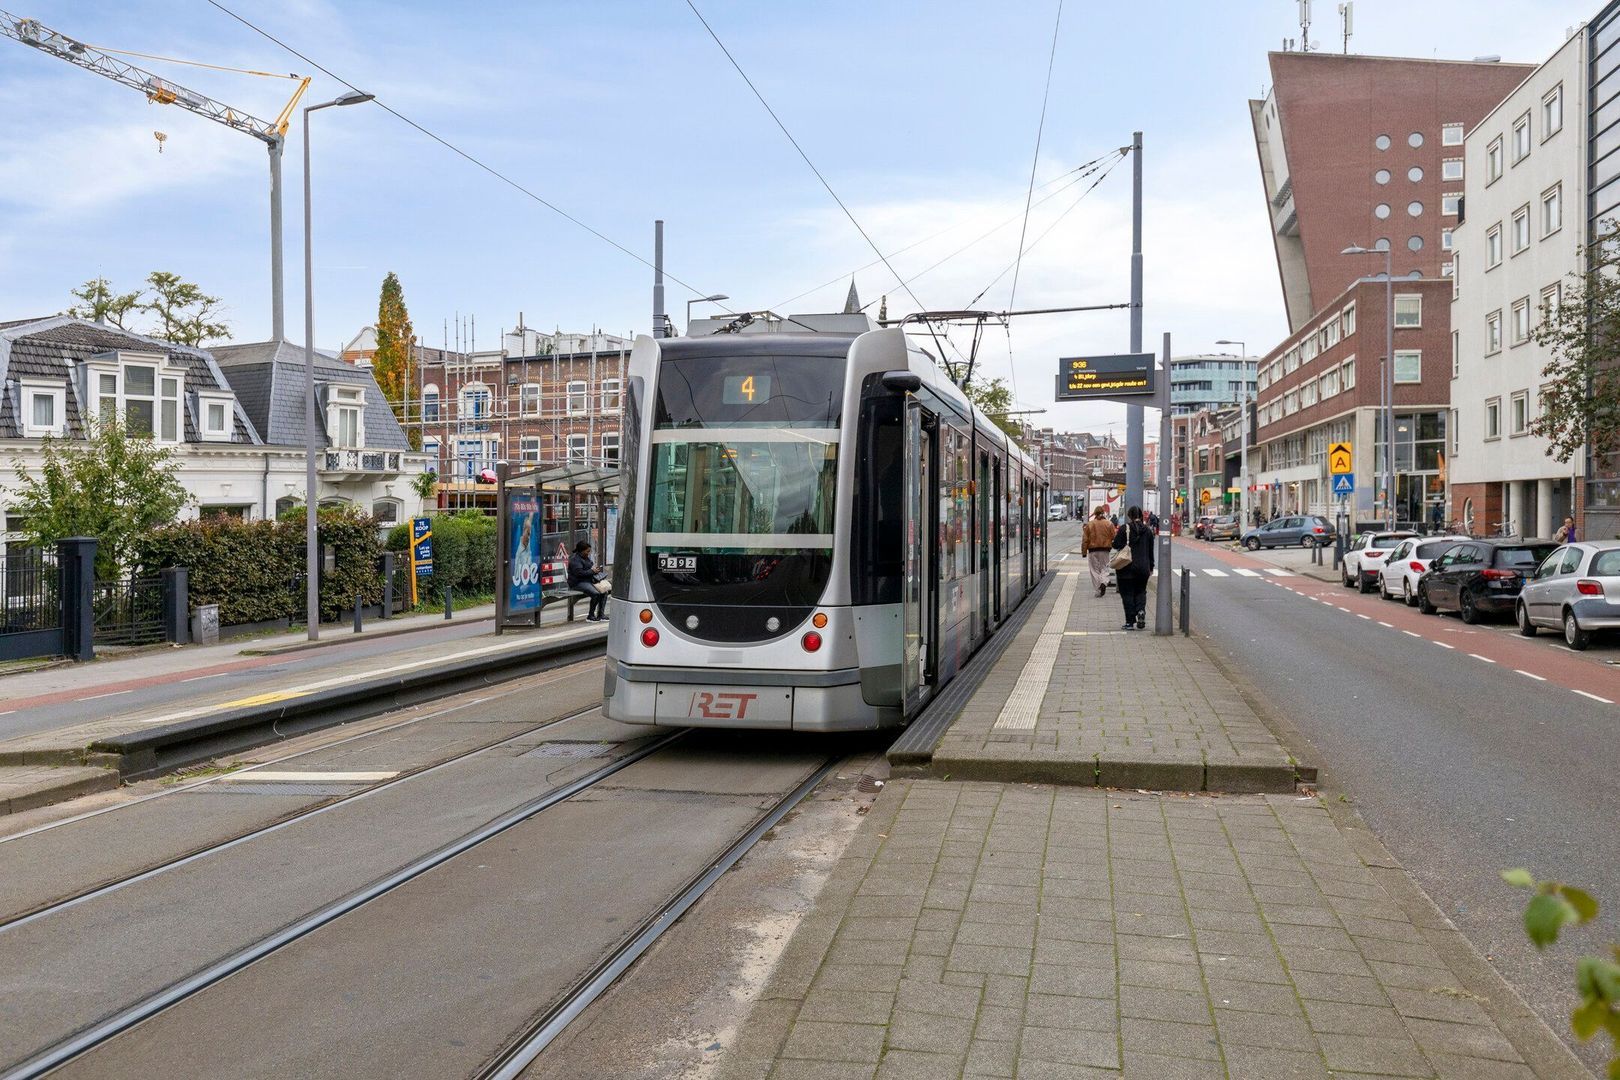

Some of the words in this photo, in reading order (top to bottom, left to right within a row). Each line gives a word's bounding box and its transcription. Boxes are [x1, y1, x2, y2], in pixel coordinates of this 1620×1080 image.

[741, 376, 755, 401] 4
[1335, 457, 1346, 468] A
[660, 558, 694, 568] 9292
[688, 692, 757, 719] RET
